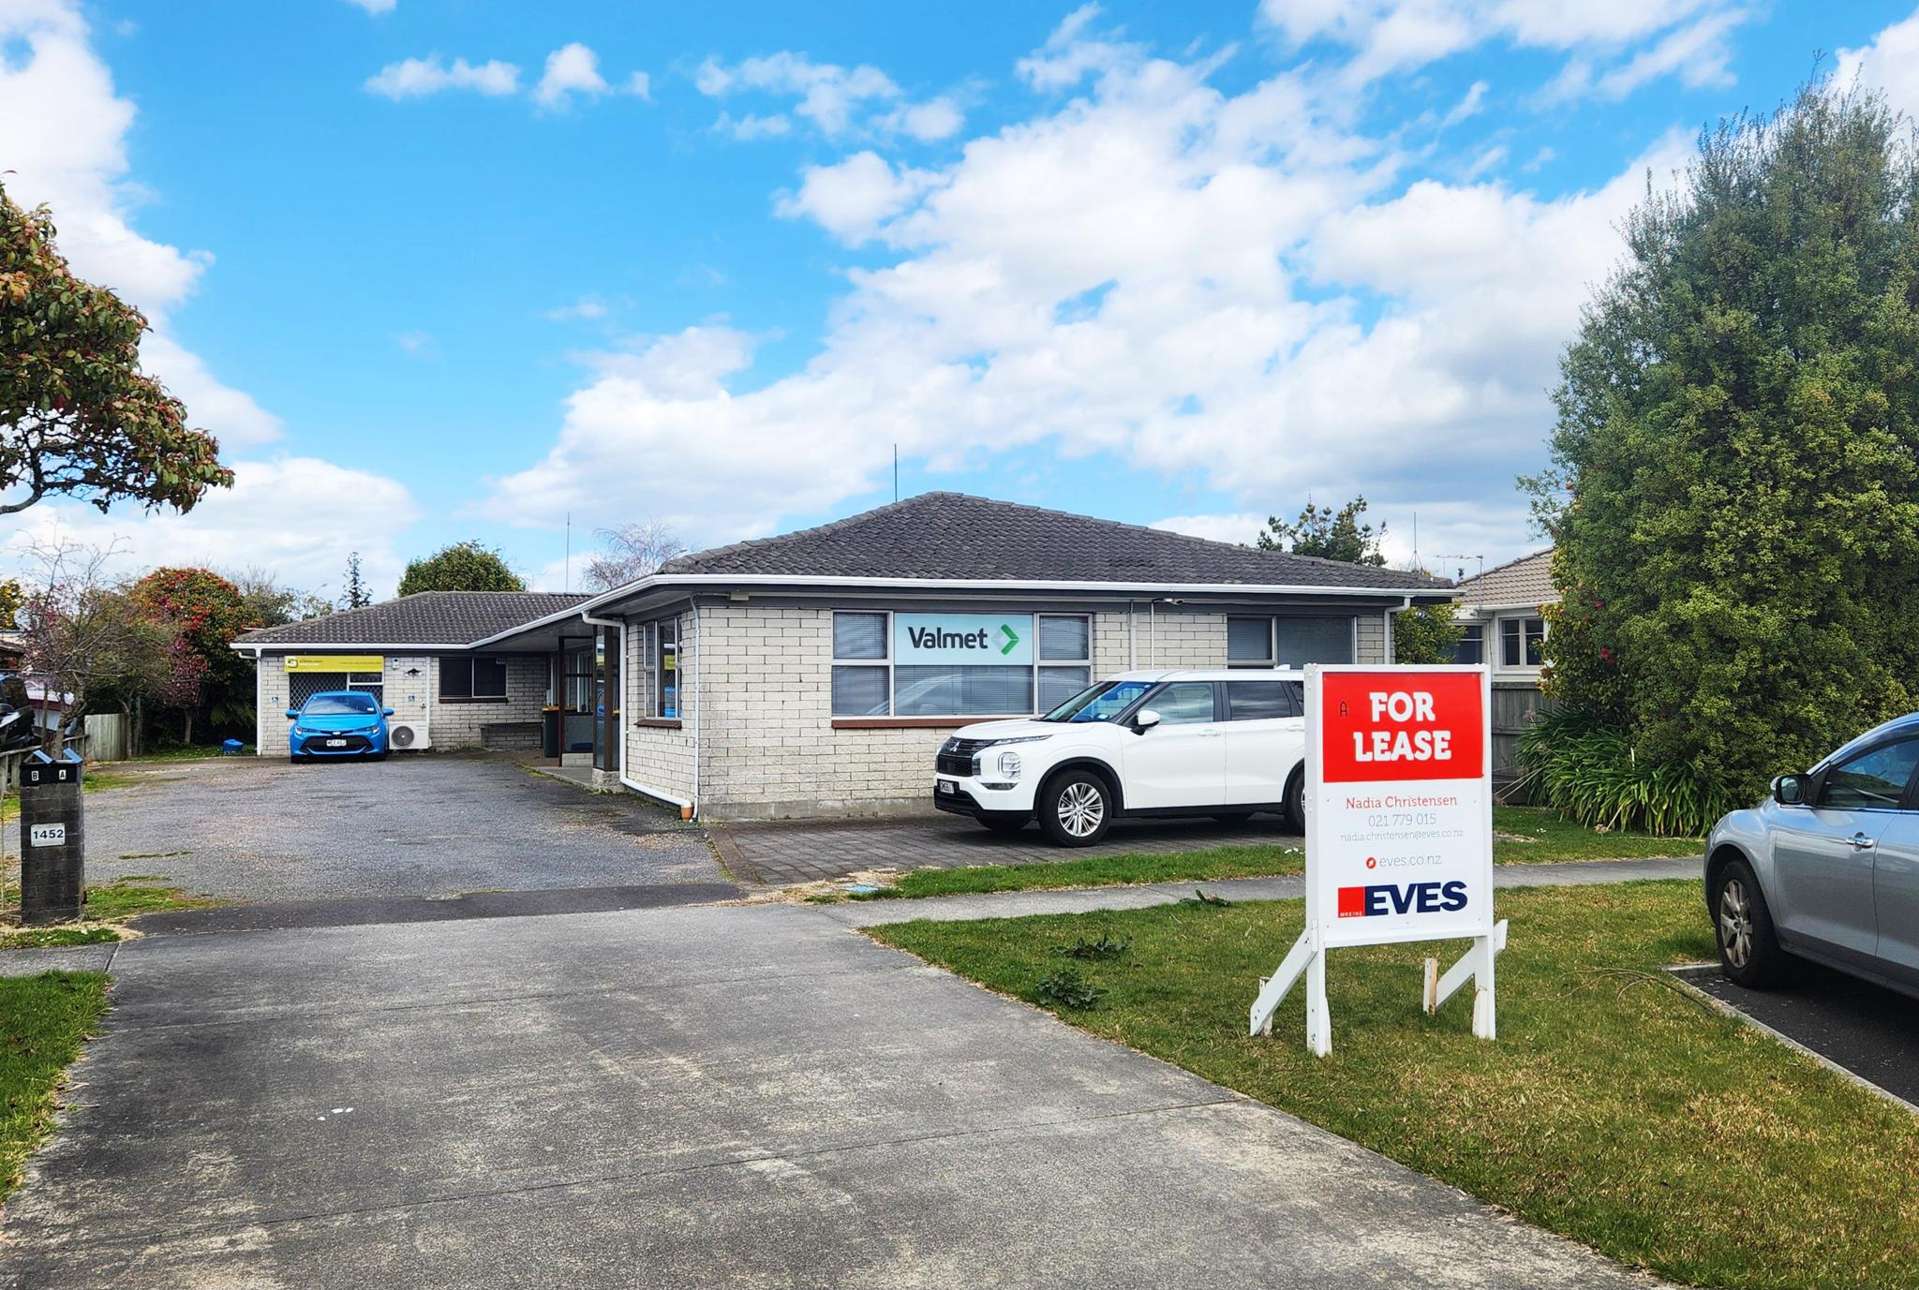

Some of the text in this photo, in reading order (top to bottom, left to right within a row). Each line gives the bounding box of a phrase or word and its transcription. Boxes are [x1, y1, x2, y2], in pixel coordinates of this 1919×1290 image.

[908, 626, 988, 649] Valmet
[1369, 691, 1436, 722] FOR
[1353, 730, 1453, 762] LEASE
[1346, 795, 1458, 809] Nadia Christensen
[1368, 812, 1437, 827] 021 779 015
[33, 829, 64, 840] 1452
[1379, 855, 1443, 867] eves.co.nz
[1365, 881, 1468, 916] EVES
